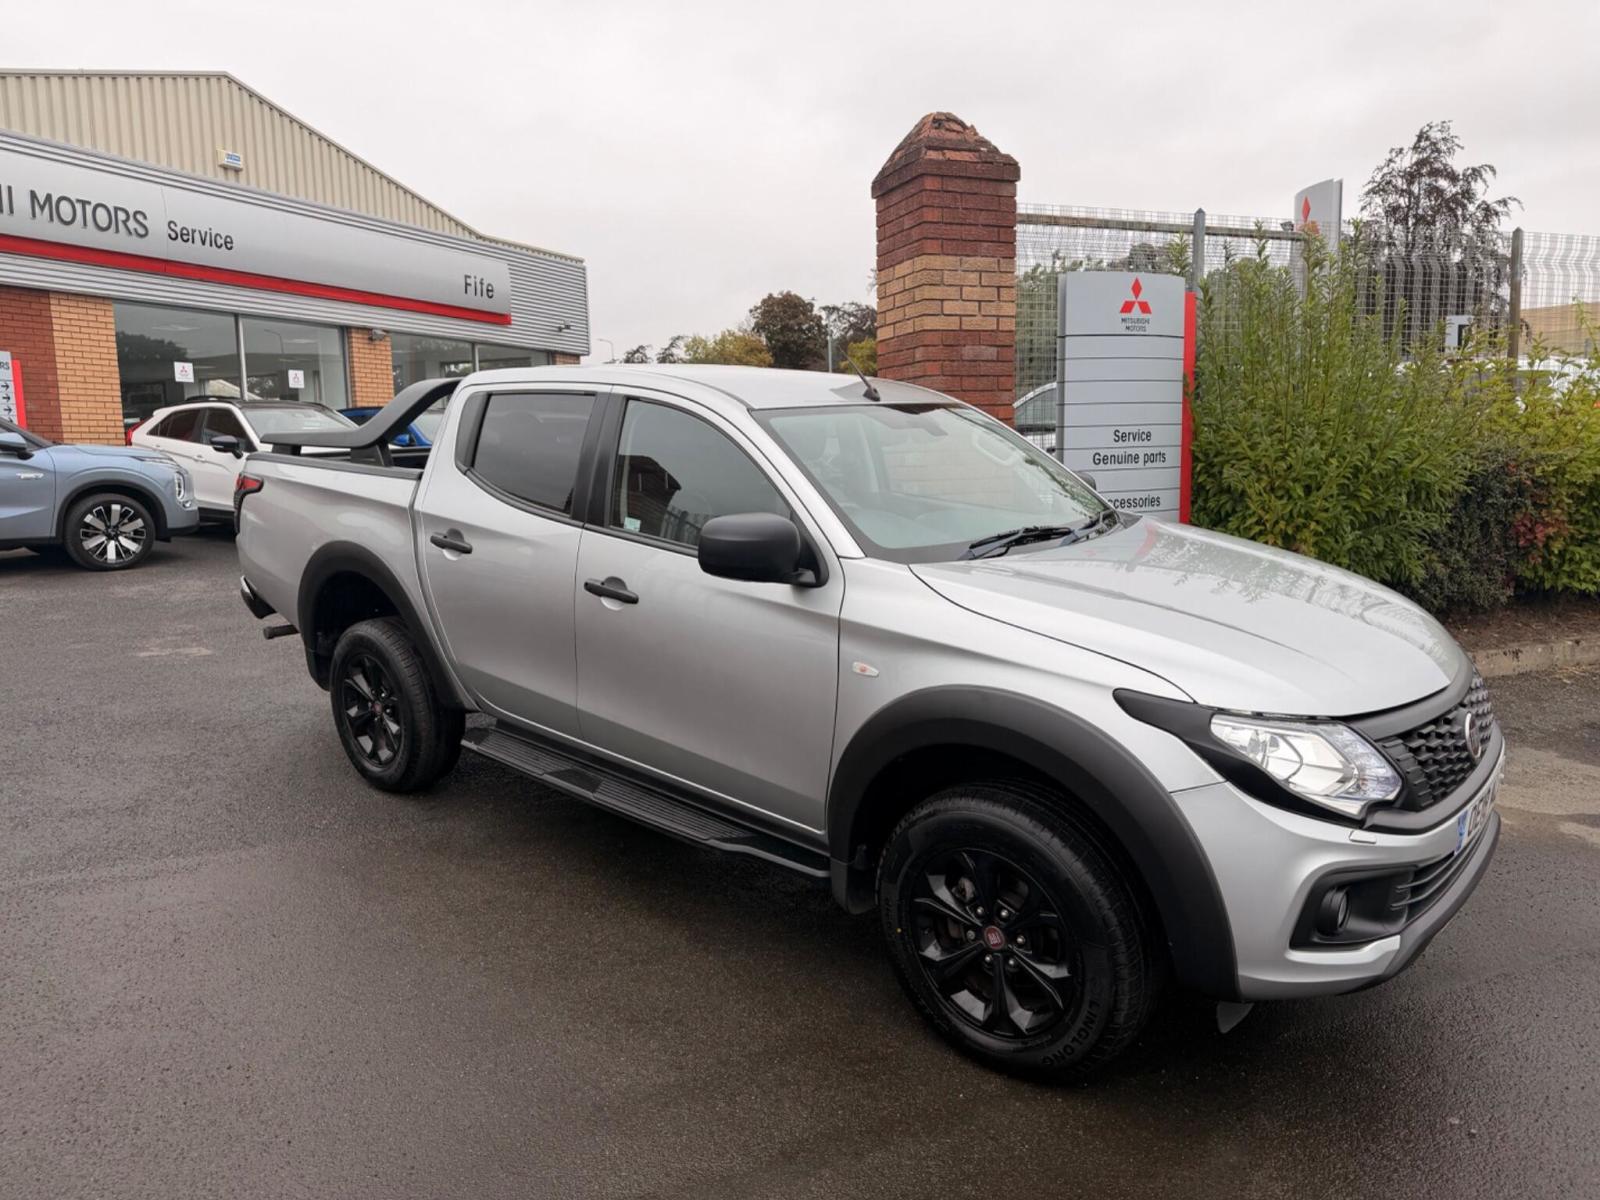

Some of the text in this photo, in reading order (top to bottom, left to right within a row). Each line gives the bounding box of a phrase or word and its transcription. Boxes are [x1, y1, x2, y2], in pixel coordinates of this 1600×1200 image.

[29, 189, 149, 239] MOTORS
[167, 220, 234, 251] Service
[464, 274, 494, 299] Fife
[1113, 429, 1152, 443] Service
[1092, 450, 1167, 466] Genuine parts
